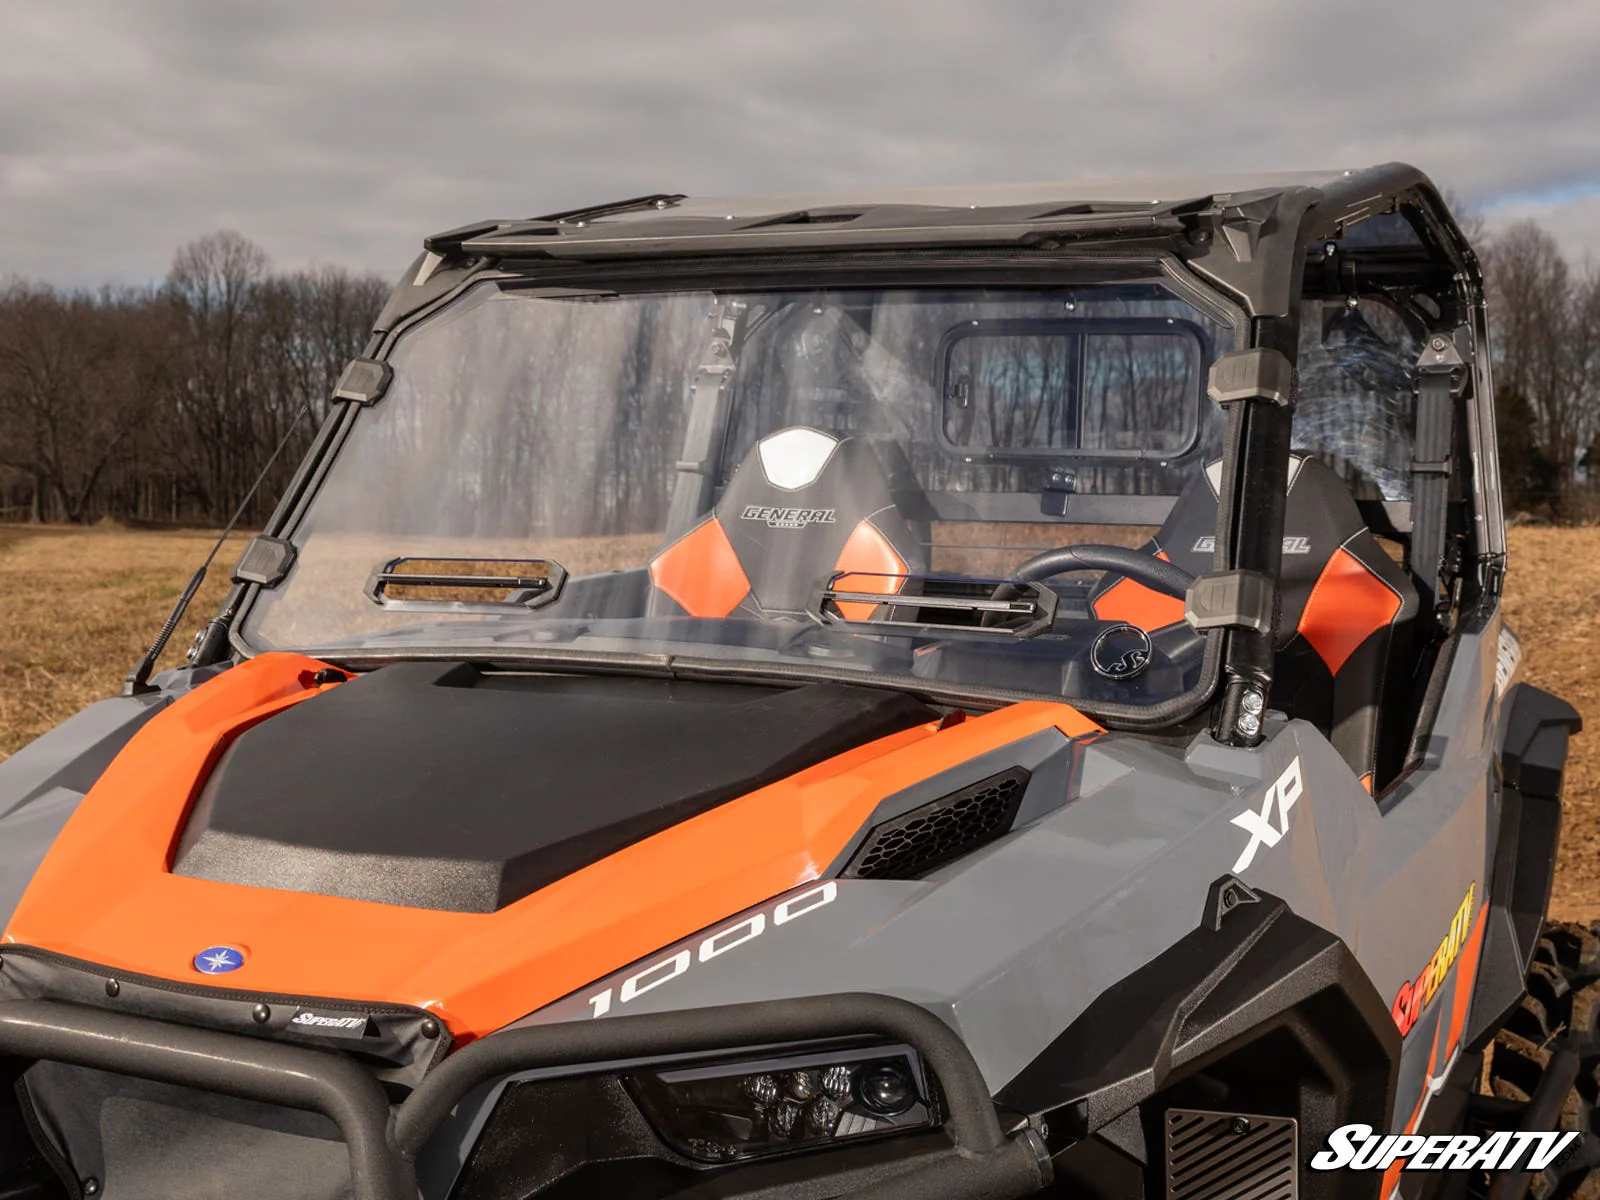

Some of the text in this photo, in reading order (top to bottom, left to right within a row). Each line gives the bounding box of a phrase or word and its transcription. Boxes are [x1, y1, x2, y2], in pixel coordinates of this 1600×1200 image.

[741, 505, 836, 524] GENERAL
[1229, 755, 1303, 874] XP
[588, 880, 838, 1019] 1000
